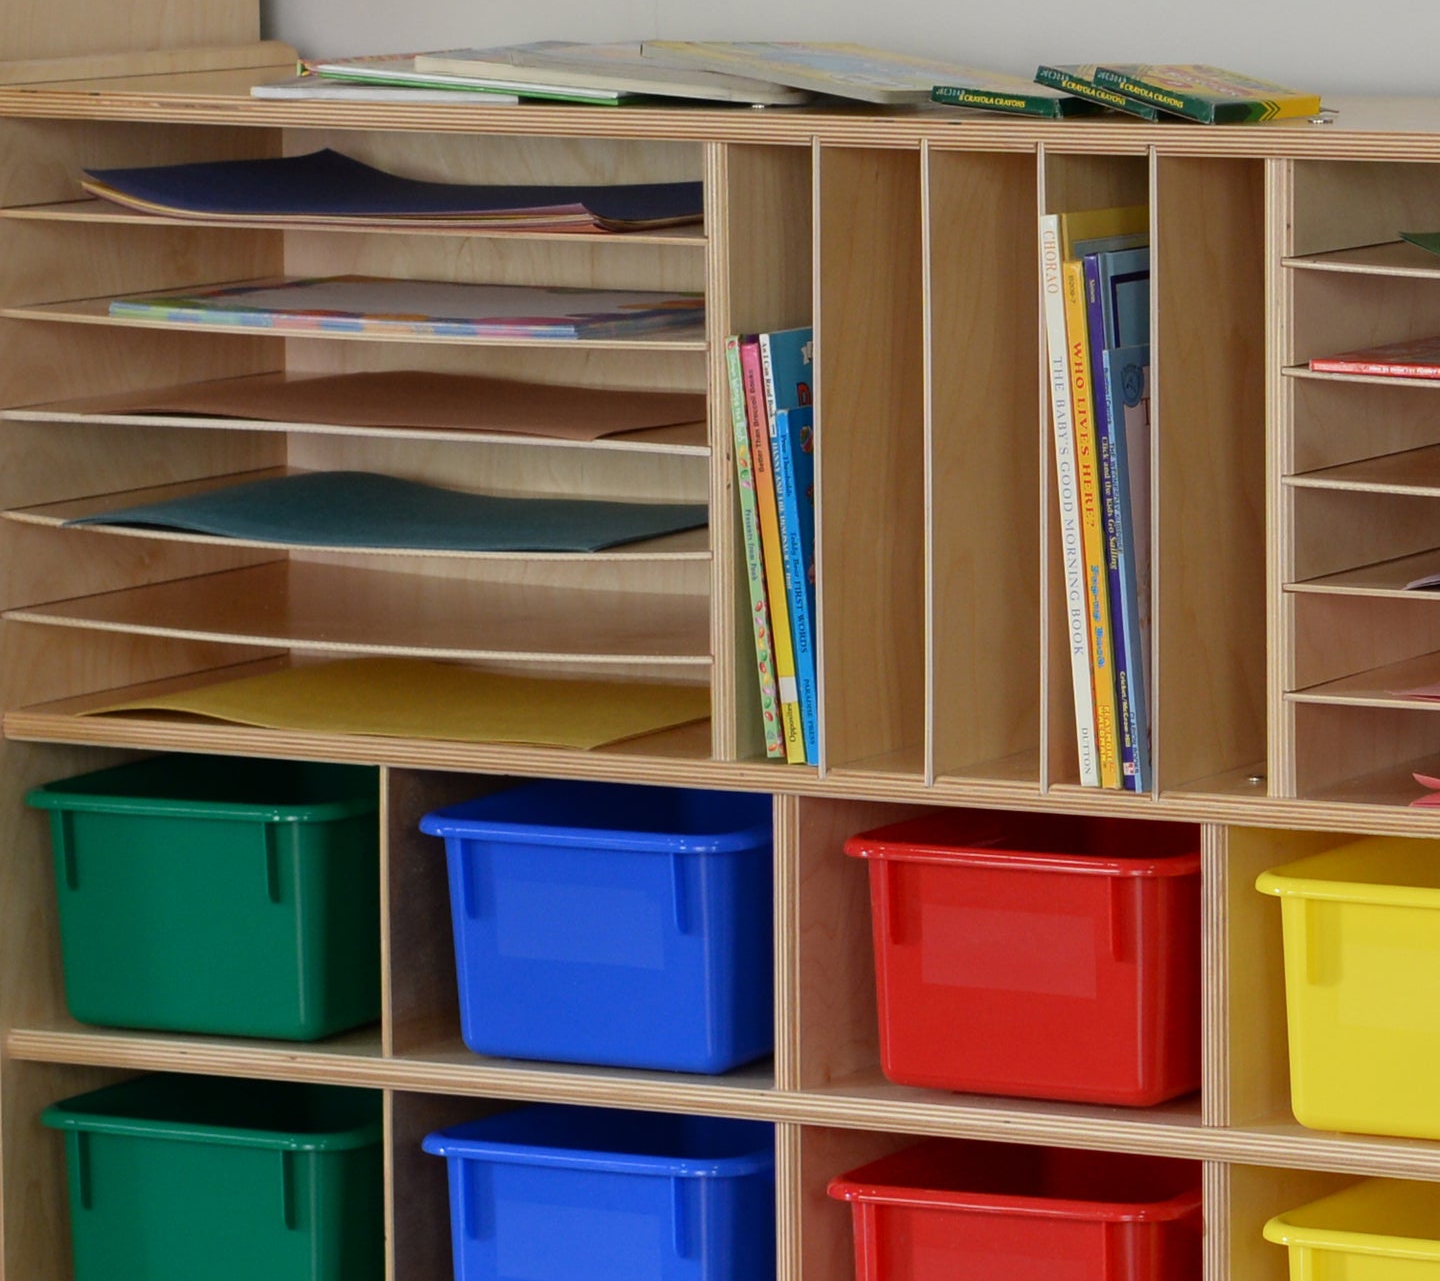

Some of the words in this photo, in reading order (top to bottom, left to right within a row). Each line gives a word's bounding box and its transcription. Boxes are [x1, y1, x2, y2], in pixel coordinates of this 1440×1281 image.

[1067, 81, 1097, 97] CRAYOLA
[1096, 90, 1126, 105] CRAYONS
[1124, 83, 1153, 99] CRAYOLA
[1154, 93, 1184, 108] CRAYONS
[1043, 230, 1059, 294] CHORAO
[1053, 356, 1065, 392] THE
[1073, 342, 1085, 390] WHO
[1056, 399, 1069, 456] BABY'S
[1077, 398, 1090, 457] LIVES
[1101, 436, 1110, 459] Click
[1060, 461, 1073, 513] GOOD
[1103, 461, 1111, 480] and
[1104, 481, 1113, 496] the
[1082, 463, 1095, 528] HERE?
[1106, 498, 1114, 518] Kids
[789, 532, 799, 557] Teddy
[1107, 519, 1115, 534] Go
[744, 509, 753, 540] Presents
[750, 563, 759, 581] Pooh
[1064, 519, 1081, 601] MORNING
[1109, 536, 1119, 570] Sailing
[793, 558, 801, 578] Bear
[794, 580, 805, 611] FIRST
[799, 614, 808, 654] WORDS
[1071, 608, 1085, 655] BOOK
[787, 702, 797, 743] Opposites
[808, 720, 816, 745] PRESS
[1081, 727, 1091, 775] DUTTON
